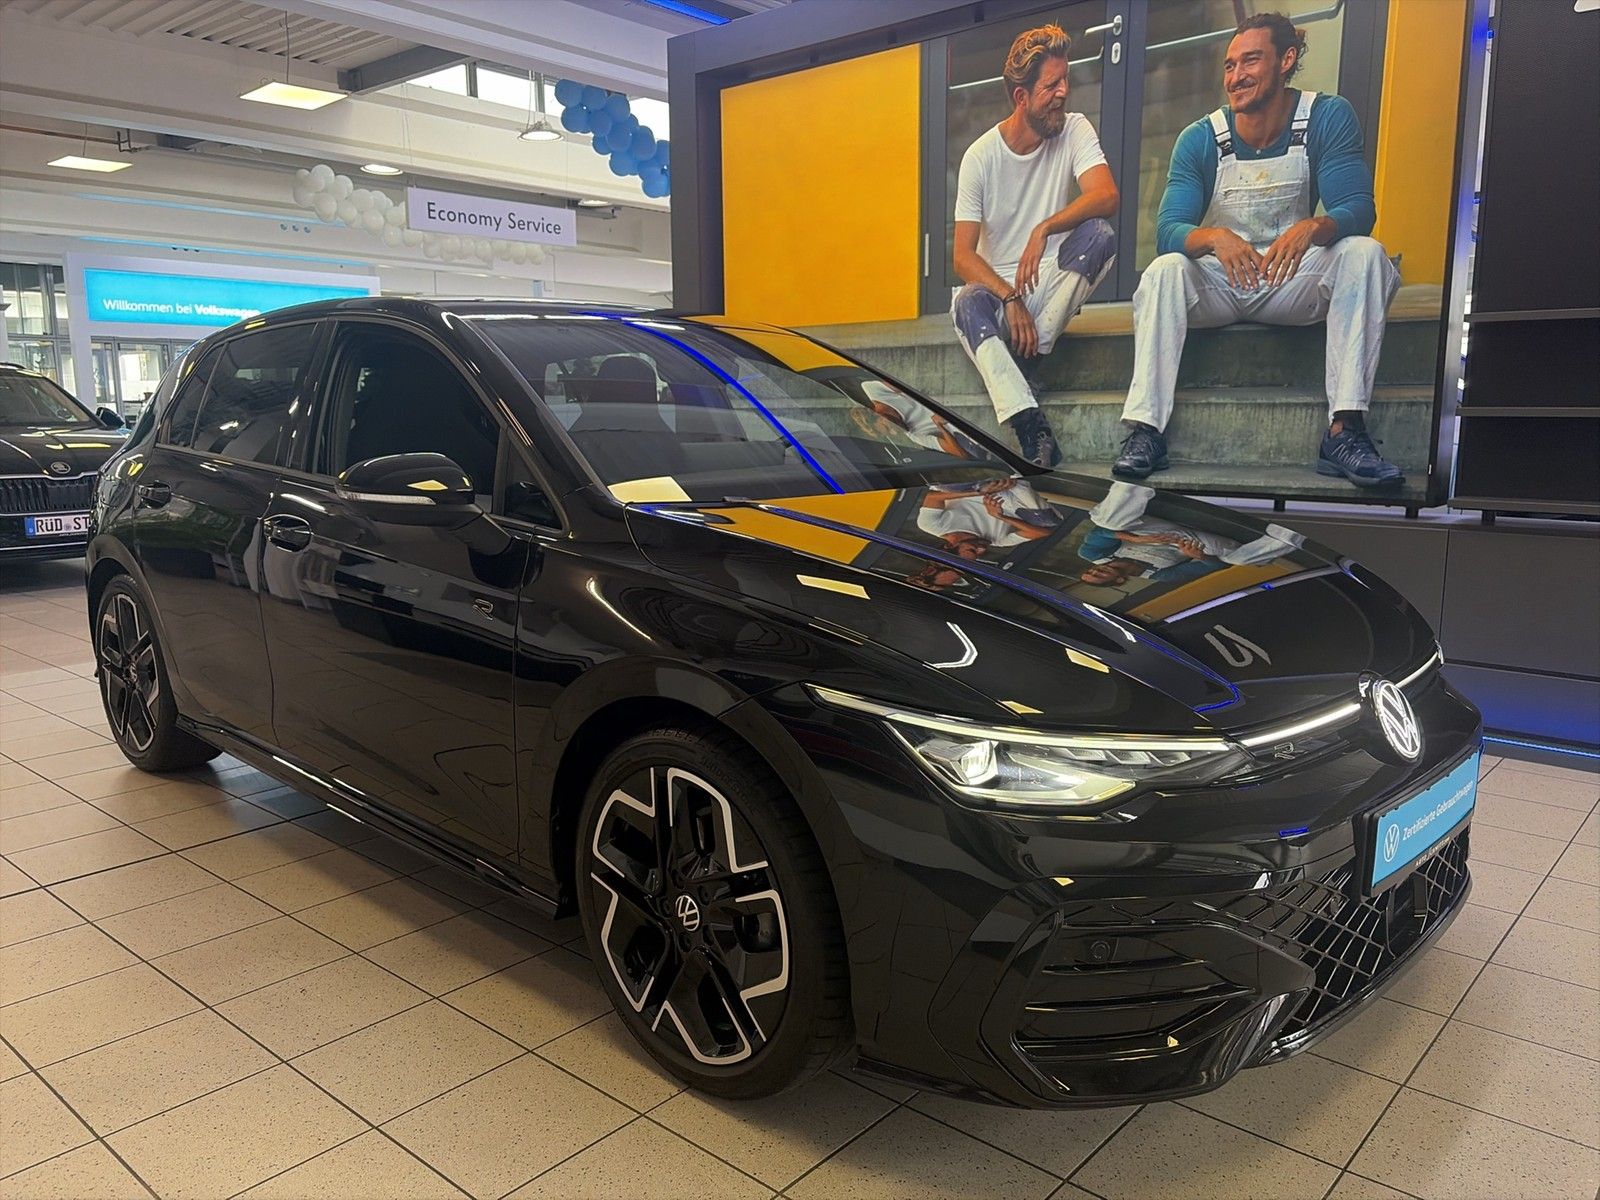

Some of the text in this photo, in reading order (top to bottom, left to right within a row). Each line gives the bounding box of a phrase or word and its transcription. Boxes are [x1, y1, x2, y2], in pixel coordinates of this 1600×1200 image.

[427, 202, 561, 235] Economy Service
[103, 299, 173, 313] Willkommen
[176, 303, 193, 314] bei
[35, 518, 63, 533] RÜD
